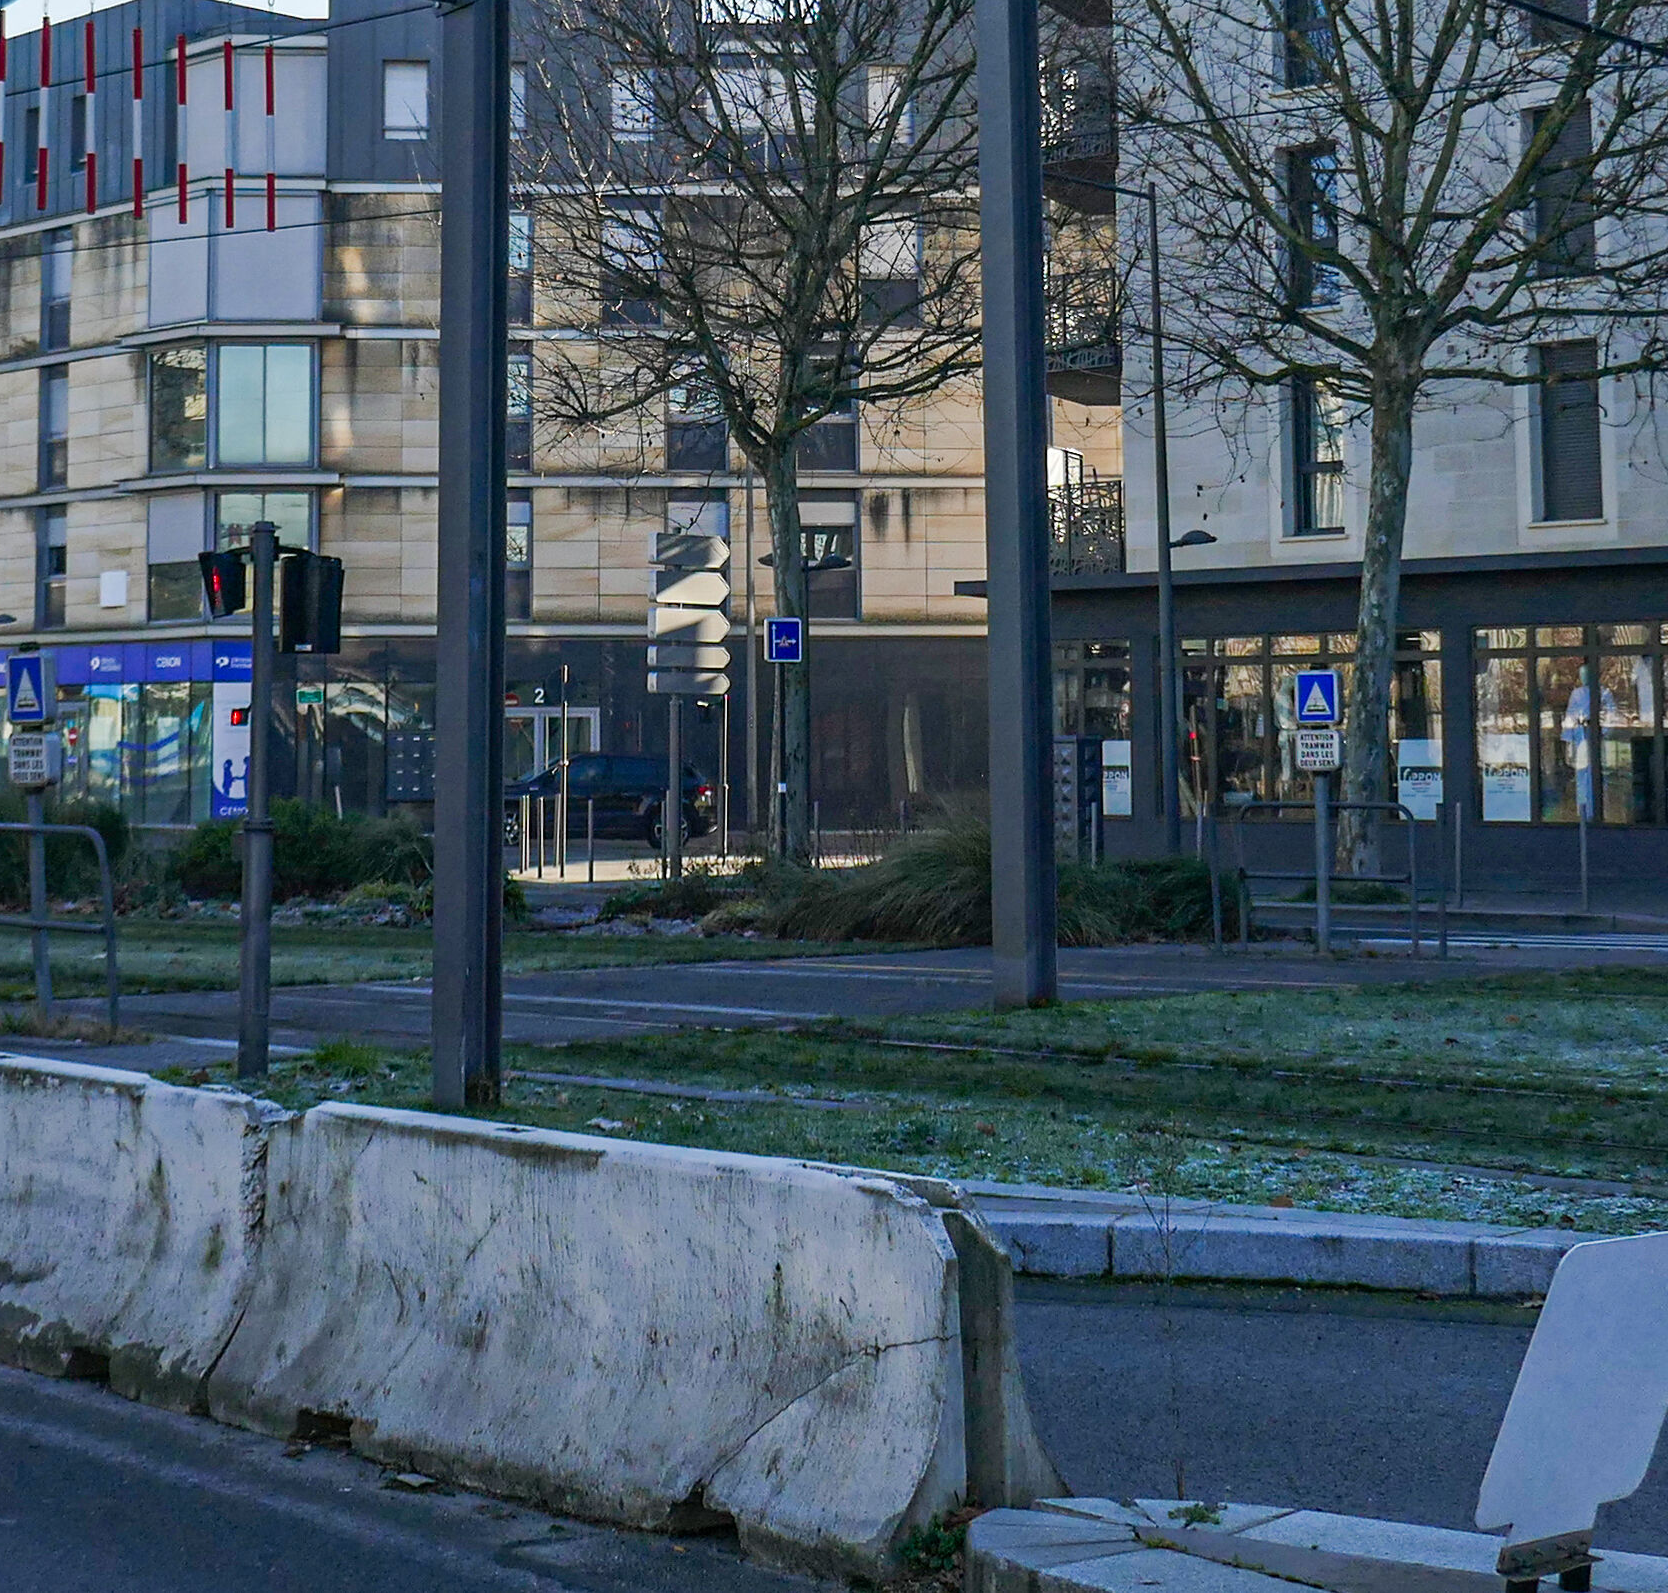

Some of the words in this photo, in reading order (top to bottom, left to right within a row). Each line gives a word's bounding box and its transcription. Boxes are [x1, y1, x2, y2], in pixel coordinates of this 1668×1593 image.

[534, 688, 545, 704] 2
[1300, 759, 1317, 767] DEUX
[1318, 759, 1335, 767] SENS
